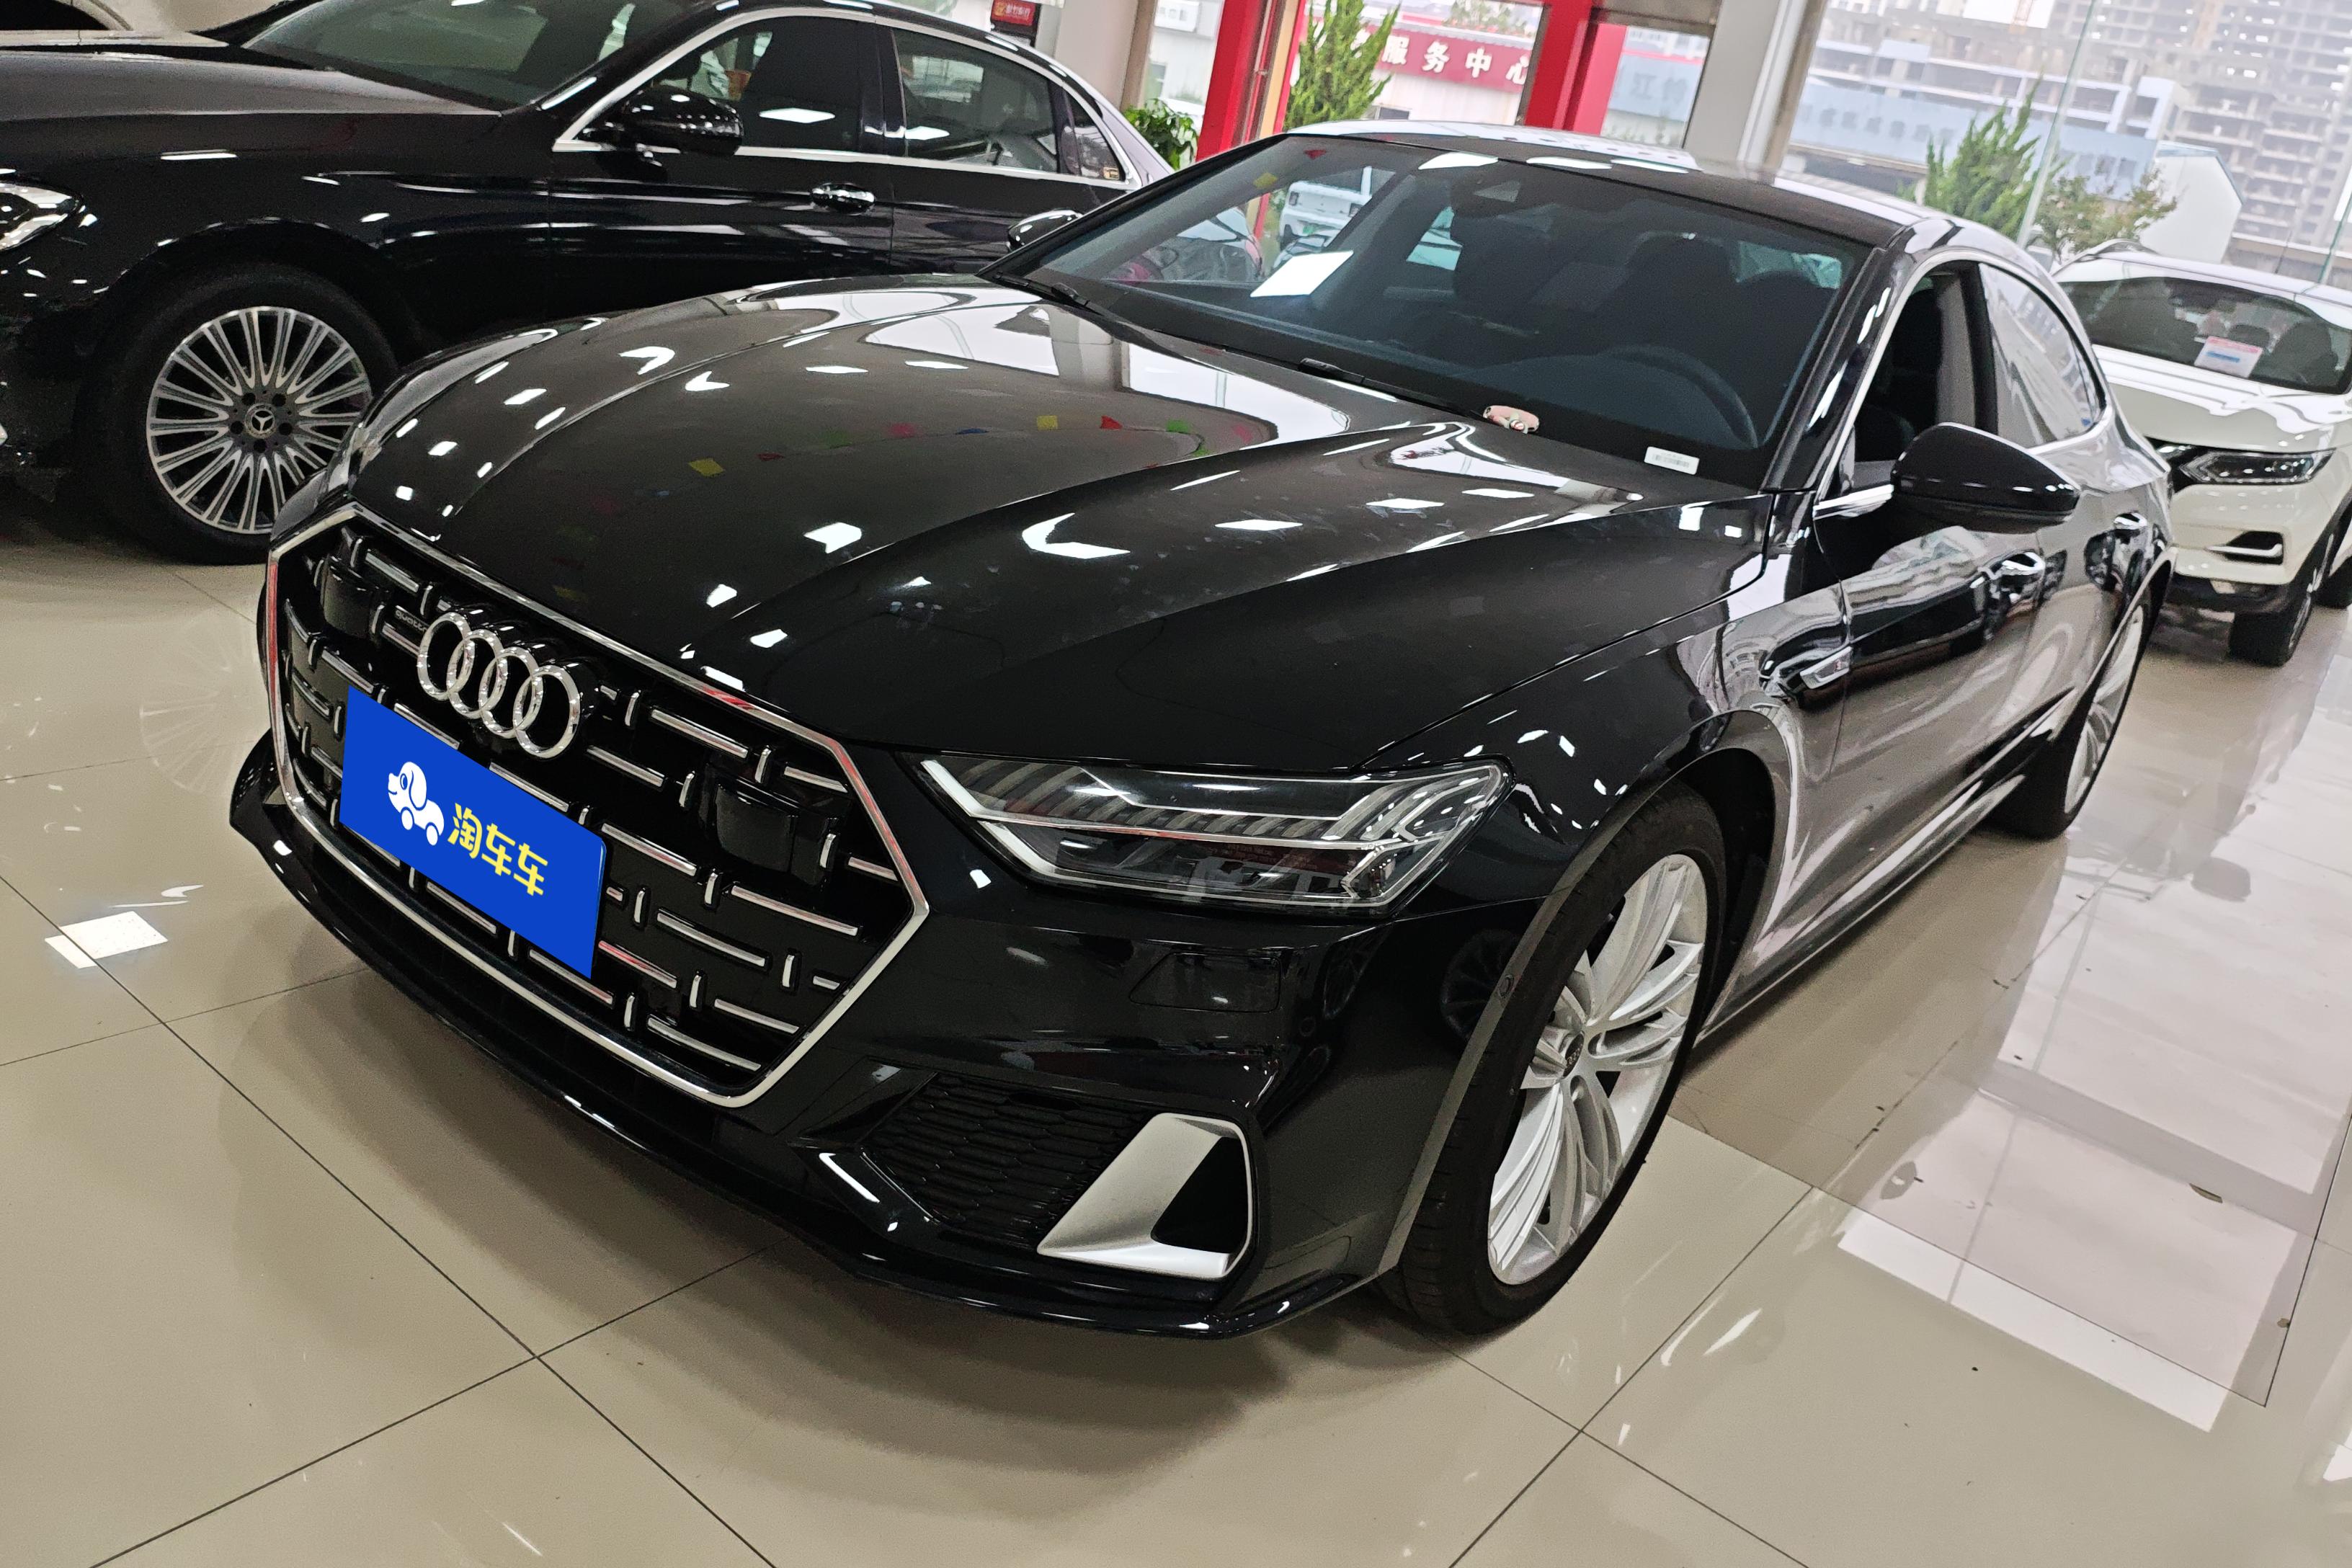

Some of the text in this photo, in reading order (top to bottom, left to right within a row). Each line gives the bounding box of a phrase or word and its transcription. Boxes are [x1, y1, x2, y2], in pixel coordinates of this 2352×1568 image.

[1381, 35, 1528, 85] 服务中心
[395, 610, 427, 633] quattr
